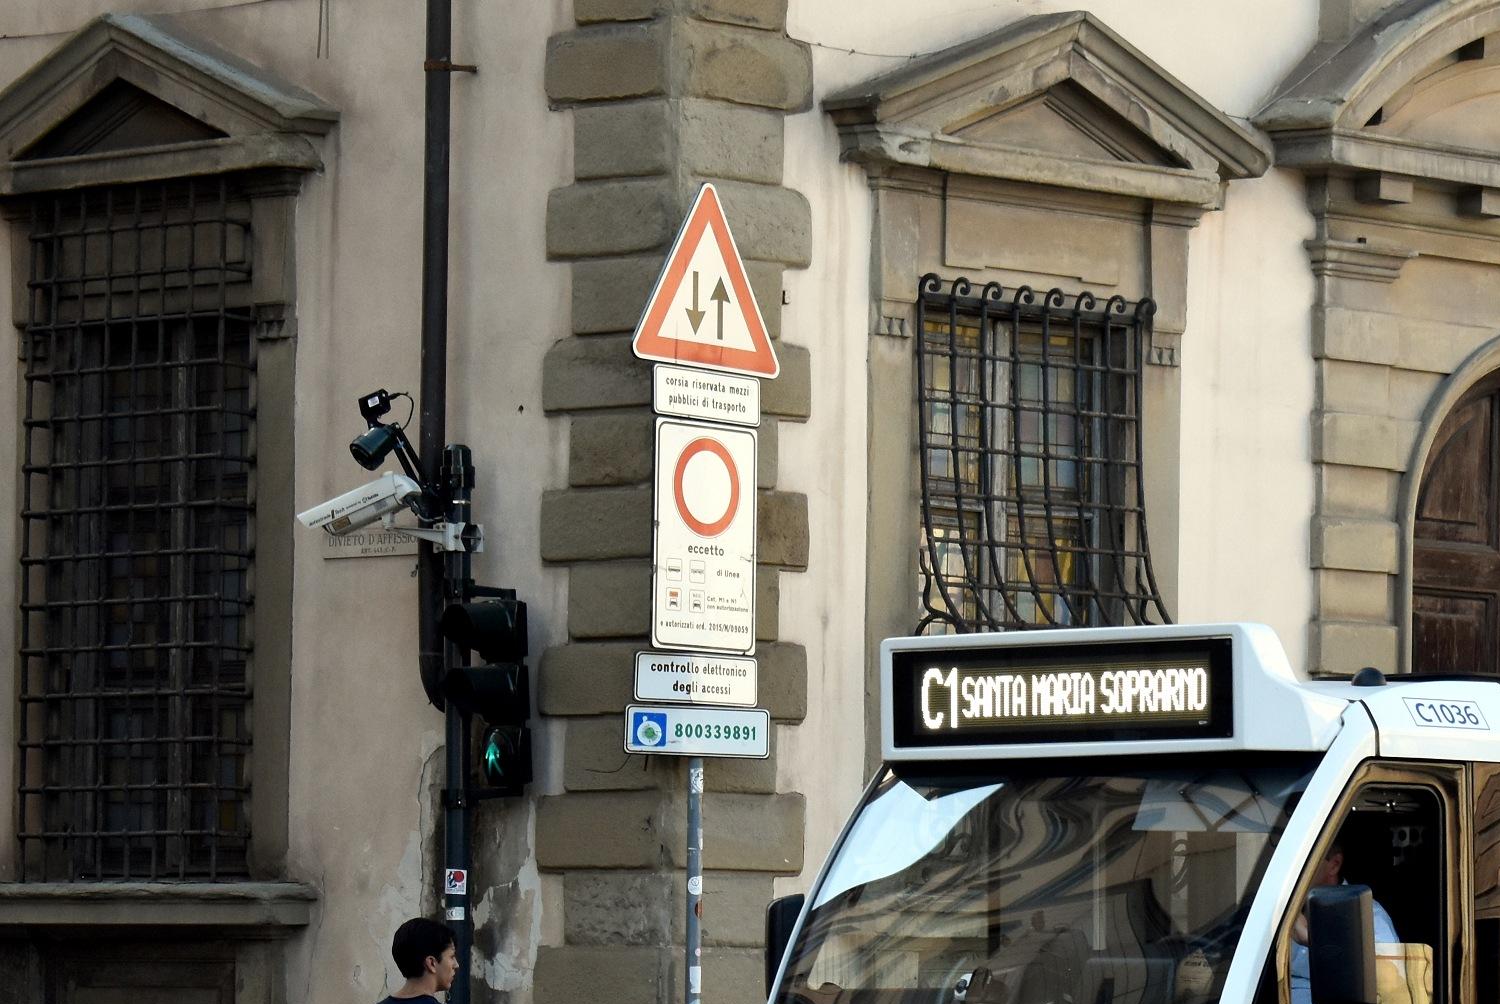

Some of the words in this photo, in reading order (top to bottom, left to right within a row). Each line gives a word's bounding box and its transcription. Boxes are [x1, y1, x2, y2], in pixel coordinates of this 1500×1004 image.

[666, 377, 688, 387] corsia
[692, 379, 726, 392] riservata
[730, 385, 750, 396] mezzi
[669, 394, 699, 405] pubblici
[702, 397, 709, 408] di
[712, 399, 746, 413] trasporto
[328, 535, 365, 547] DIVIETO
[369, 533, 418, 545] D'AFFISSIO
[688, 544, 725, 556] eccetto
[716, 569, 723, 577] di
[725, 569, 740, 578] linea
[666, 620, 694, 629] autorizzati
[651, 661, 699, 674] controllo
[702, 662, 747, 678] elettronico
[672, 680, 698, 694] degli
[701, 684, 731, 695] accessi
[921, 667, 958, 730] C1
[961, 674, 1026, 718] SANTA
[1031, 671, 1096, 716] MARIA
[1099, 667, 1208, 715] SOPRARNO
[1415, 702, 1480, 726] C1036
[674, 723, 756, 741] 800339891
